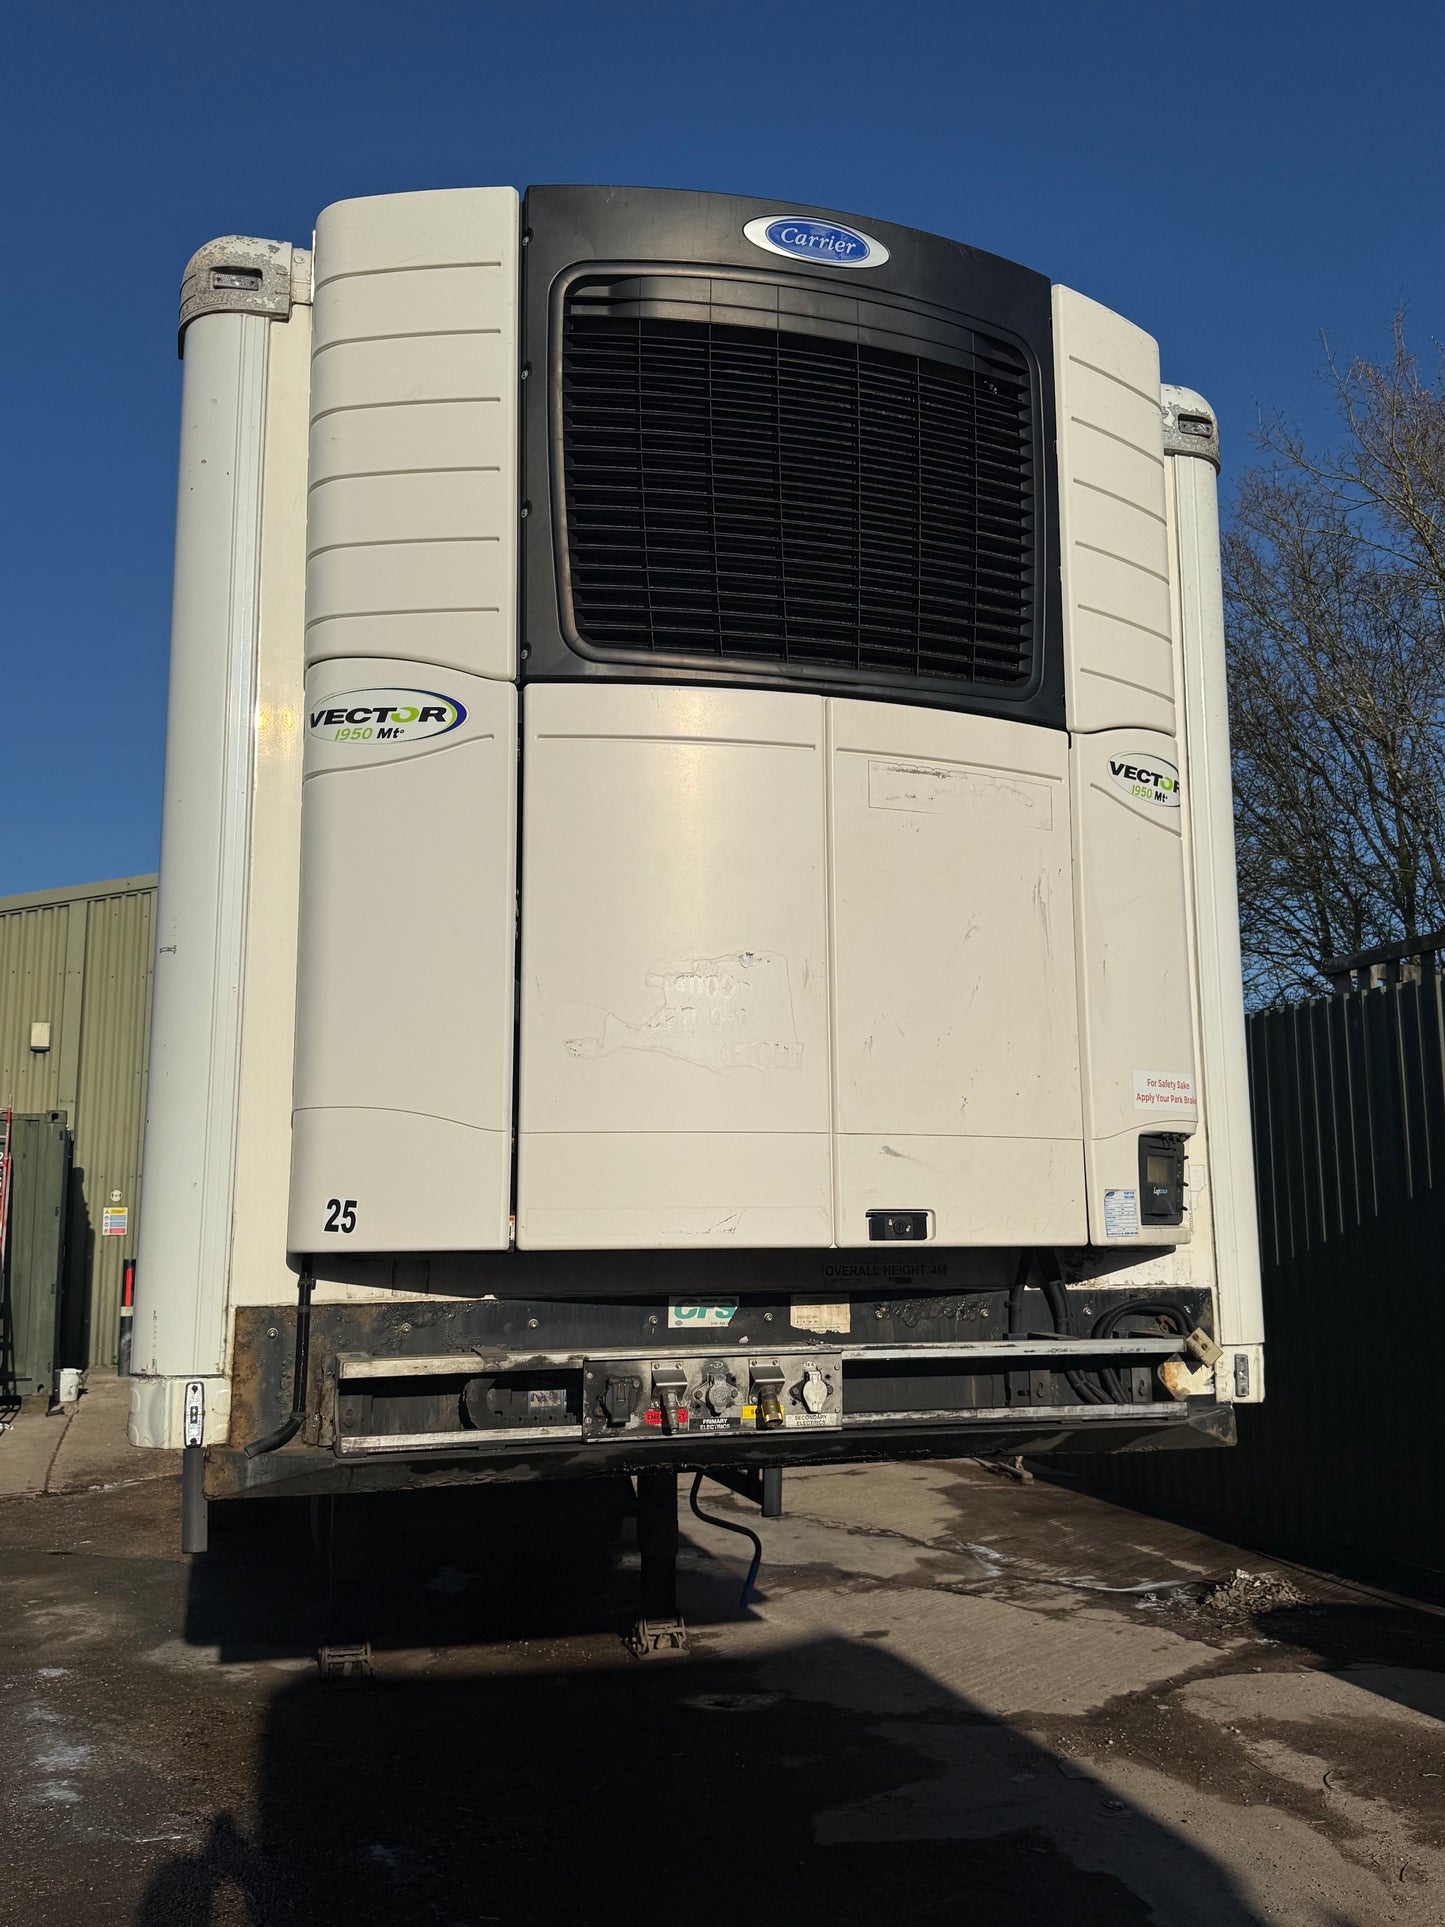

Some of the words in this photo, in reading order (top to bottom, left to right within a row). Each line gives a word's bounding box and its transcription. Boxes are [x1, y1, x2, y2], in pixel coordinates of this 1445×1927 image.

[780, 227, 857, 255] Carrier
[310, 706, 448, 729] VECTOR
[334, 727, 373, 741] 1950
[1131, 784, 1153, 799] 1950
[1146, 1078, 1157, 1088] For
[1158, 1079, 1176, 1091] Safety
[1177, 1080, 1190, 1090] Sake
[1136, 1092, 1155, 1104] Apply
[1156, 1093, 1170, 1103] Your
[1170, 1094, 1183, 1104] Park
[324, 1198, 358, 1234] 25
[825, 1265, 880, 1276] OVERALL
[883, 1264, 926, 1276] HEIGHT
